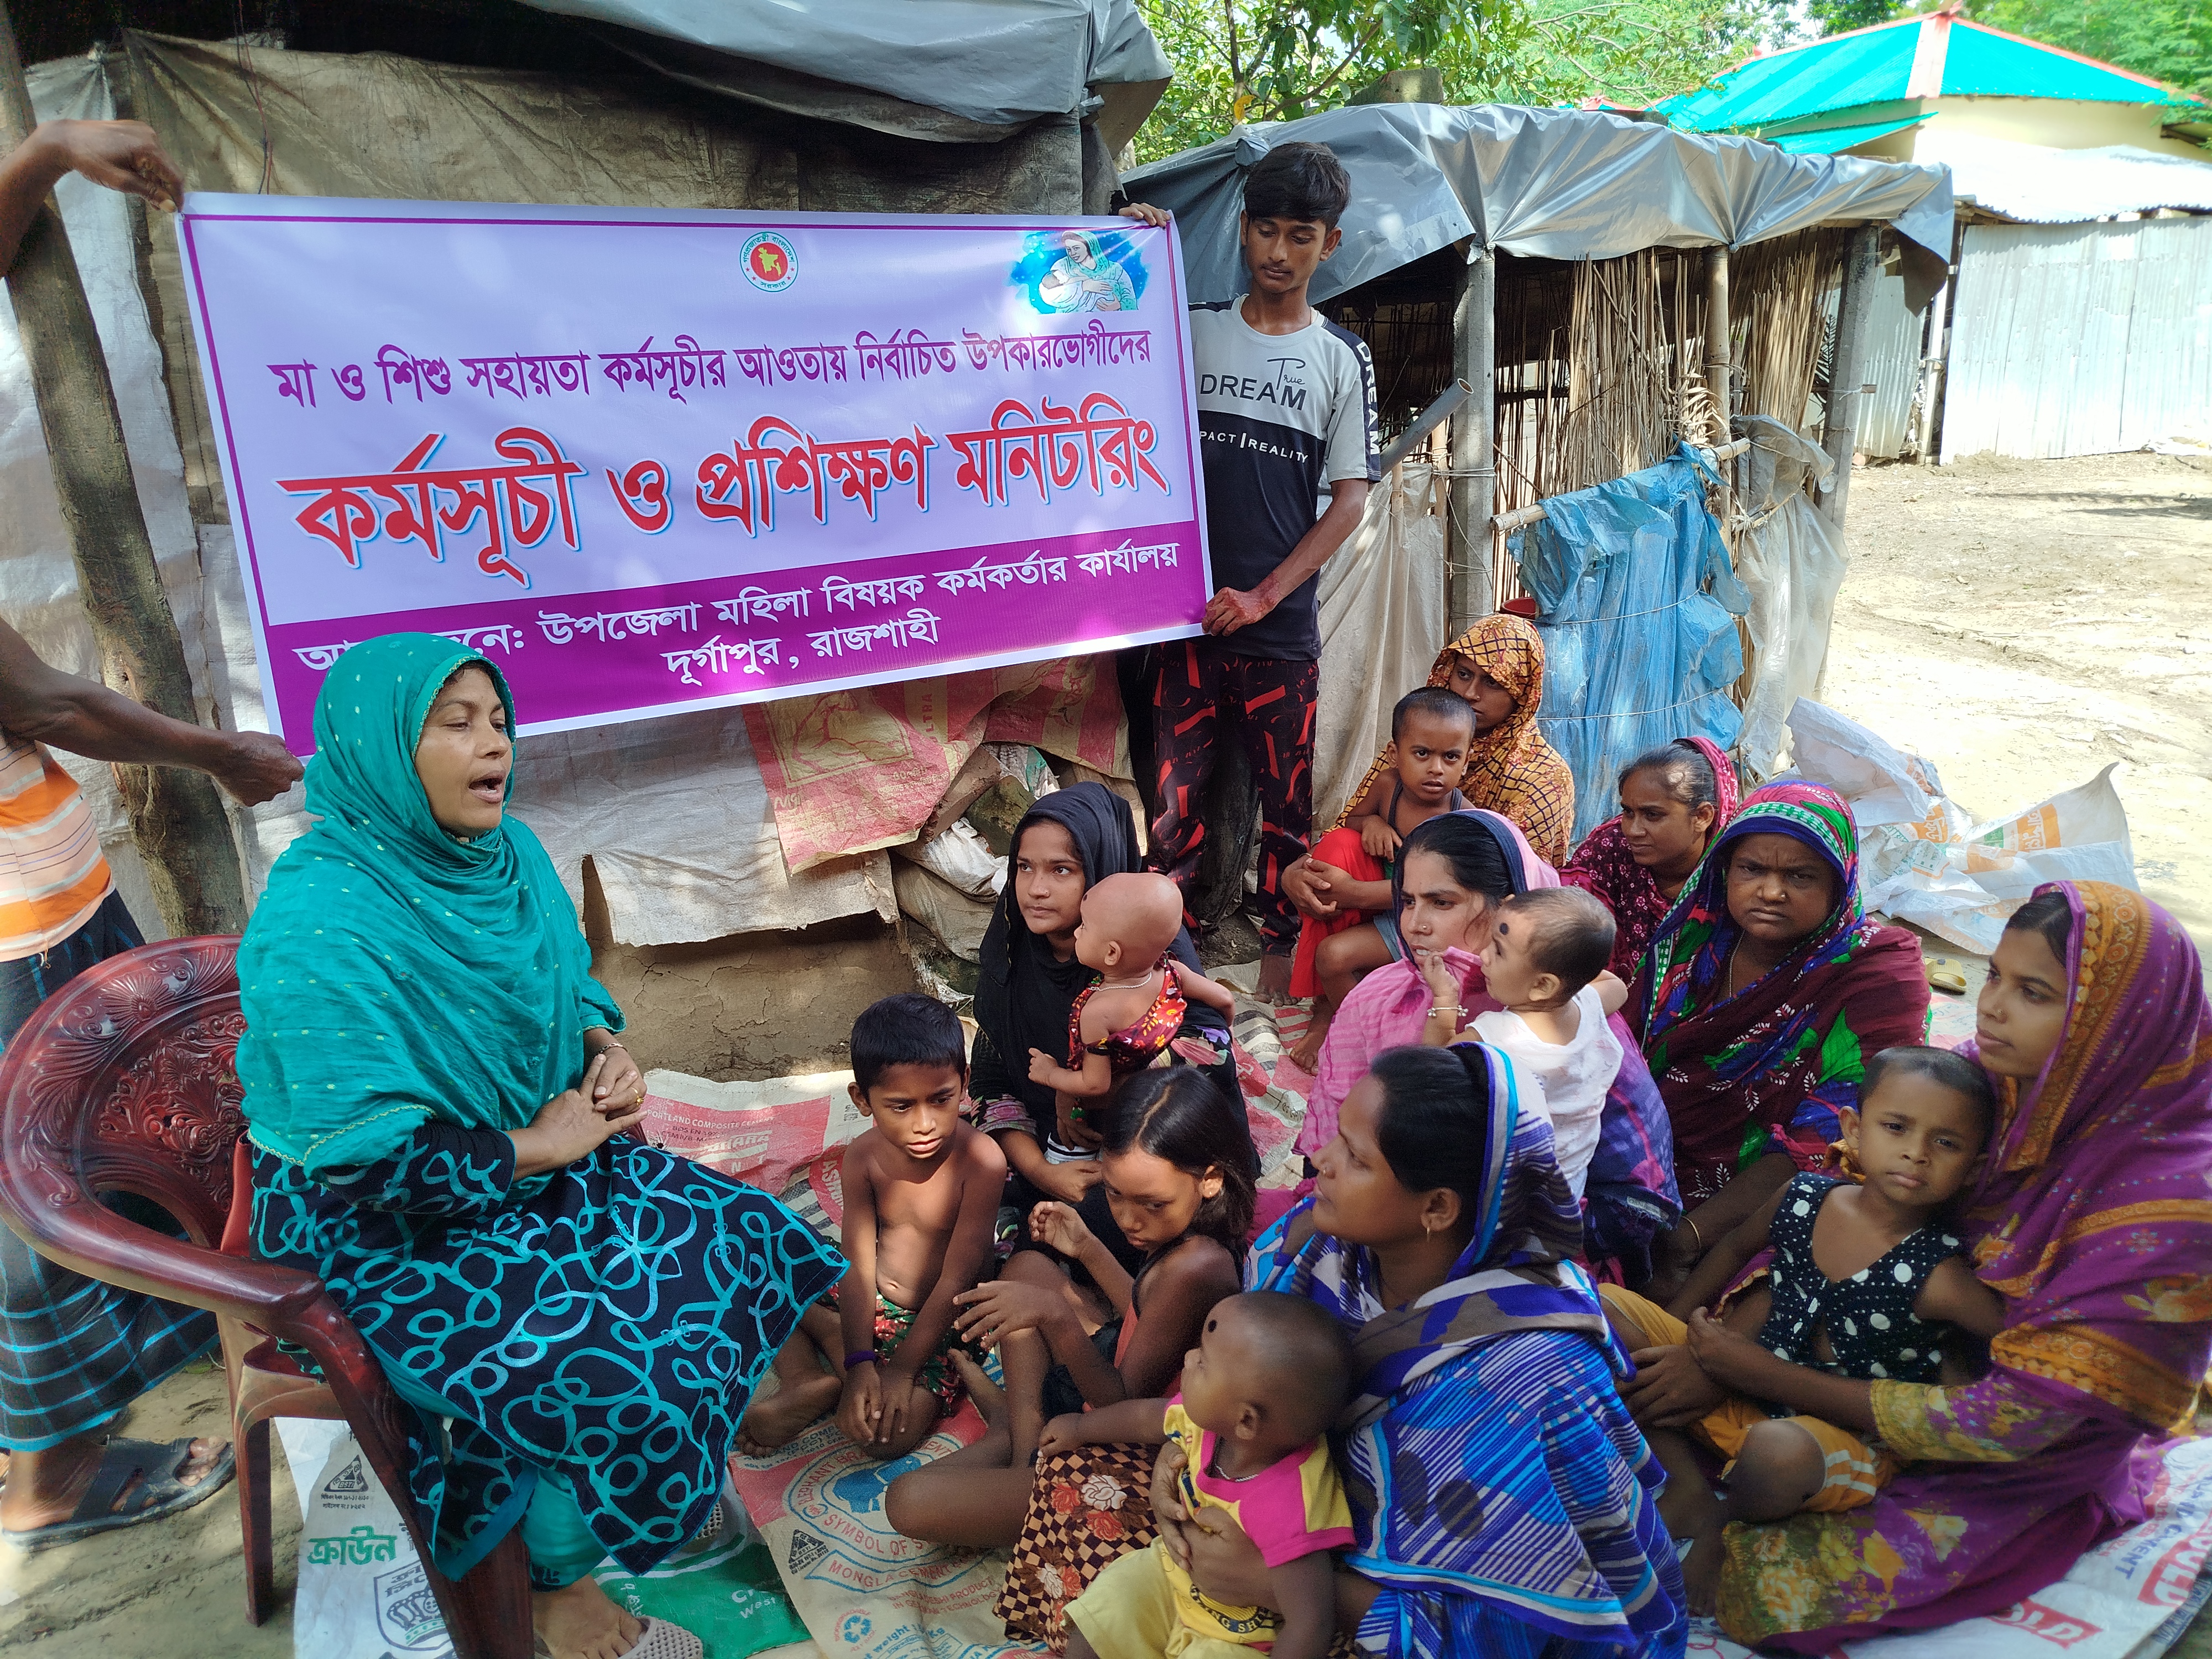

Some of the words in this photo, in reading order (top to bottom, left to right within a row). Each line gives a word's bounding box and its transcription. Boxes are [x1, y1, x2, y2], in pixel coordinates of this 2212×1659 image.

[772, 236, 795, 263] বাংলাদেশ
[760, 280, 786, 289] সরকার
[267, 358, 318, 408] মা
[331, 363, 367, 402] ও
[373, 343, 451, 404] শিশু
[458, 349, 592, 400] সহায়তা
[597, 334, 727, 405] কর্মসূচীর
[733, 342, 848, 387] আওতায়
[853, 328, 957, 382] নির্বাচিত
[962, 318, 1152, 372] উপকারভোগীদের
[1267, 357, 1306, 390] True
[1199, 373, 1307, 411] DREAM
[1357, 341, 1380, 456] DREAM
[1248, 439, 1309, 463] REALITY
[275, 426, 583, 586] কর্মসূচী
[606, 458, 670, 533] ও
[695, 415, 936, 536] প্রশিক্ষণ
[945, 392, 1168, 504] মনিটরিং
[535, 601, 703, 644] উপজেলা
[709, 586, 814, 625] মহিলা
[818, 575, 927, 612] বিষয়ক
[932, 550, 1069, 597] কর্মকর্তার
[1073, 538, 1181, 577] কার্যালয়
[806, 608, 942, 659] রাজশাহী
[647, 1108, 691, 1125] PORTLAND
[692, 1118, 739, 1130] COMPOSITE
[307, 1525, 398, 1566] ক্রাউন
[823, 1514, 885, 1554] SYMBOL
[889, 1540, 909, 1556] OF
[2114, 1523, 2183, 1581] CMENT
[828, 1559, 894, 1588] MONGLA
[898, 1563, 952, 1580] CEMENT
[950, 1576, 995, 1601] PRODUCT
[739, 1596, 776, 1619] West
[872, 1624, 911, 1653] weight
